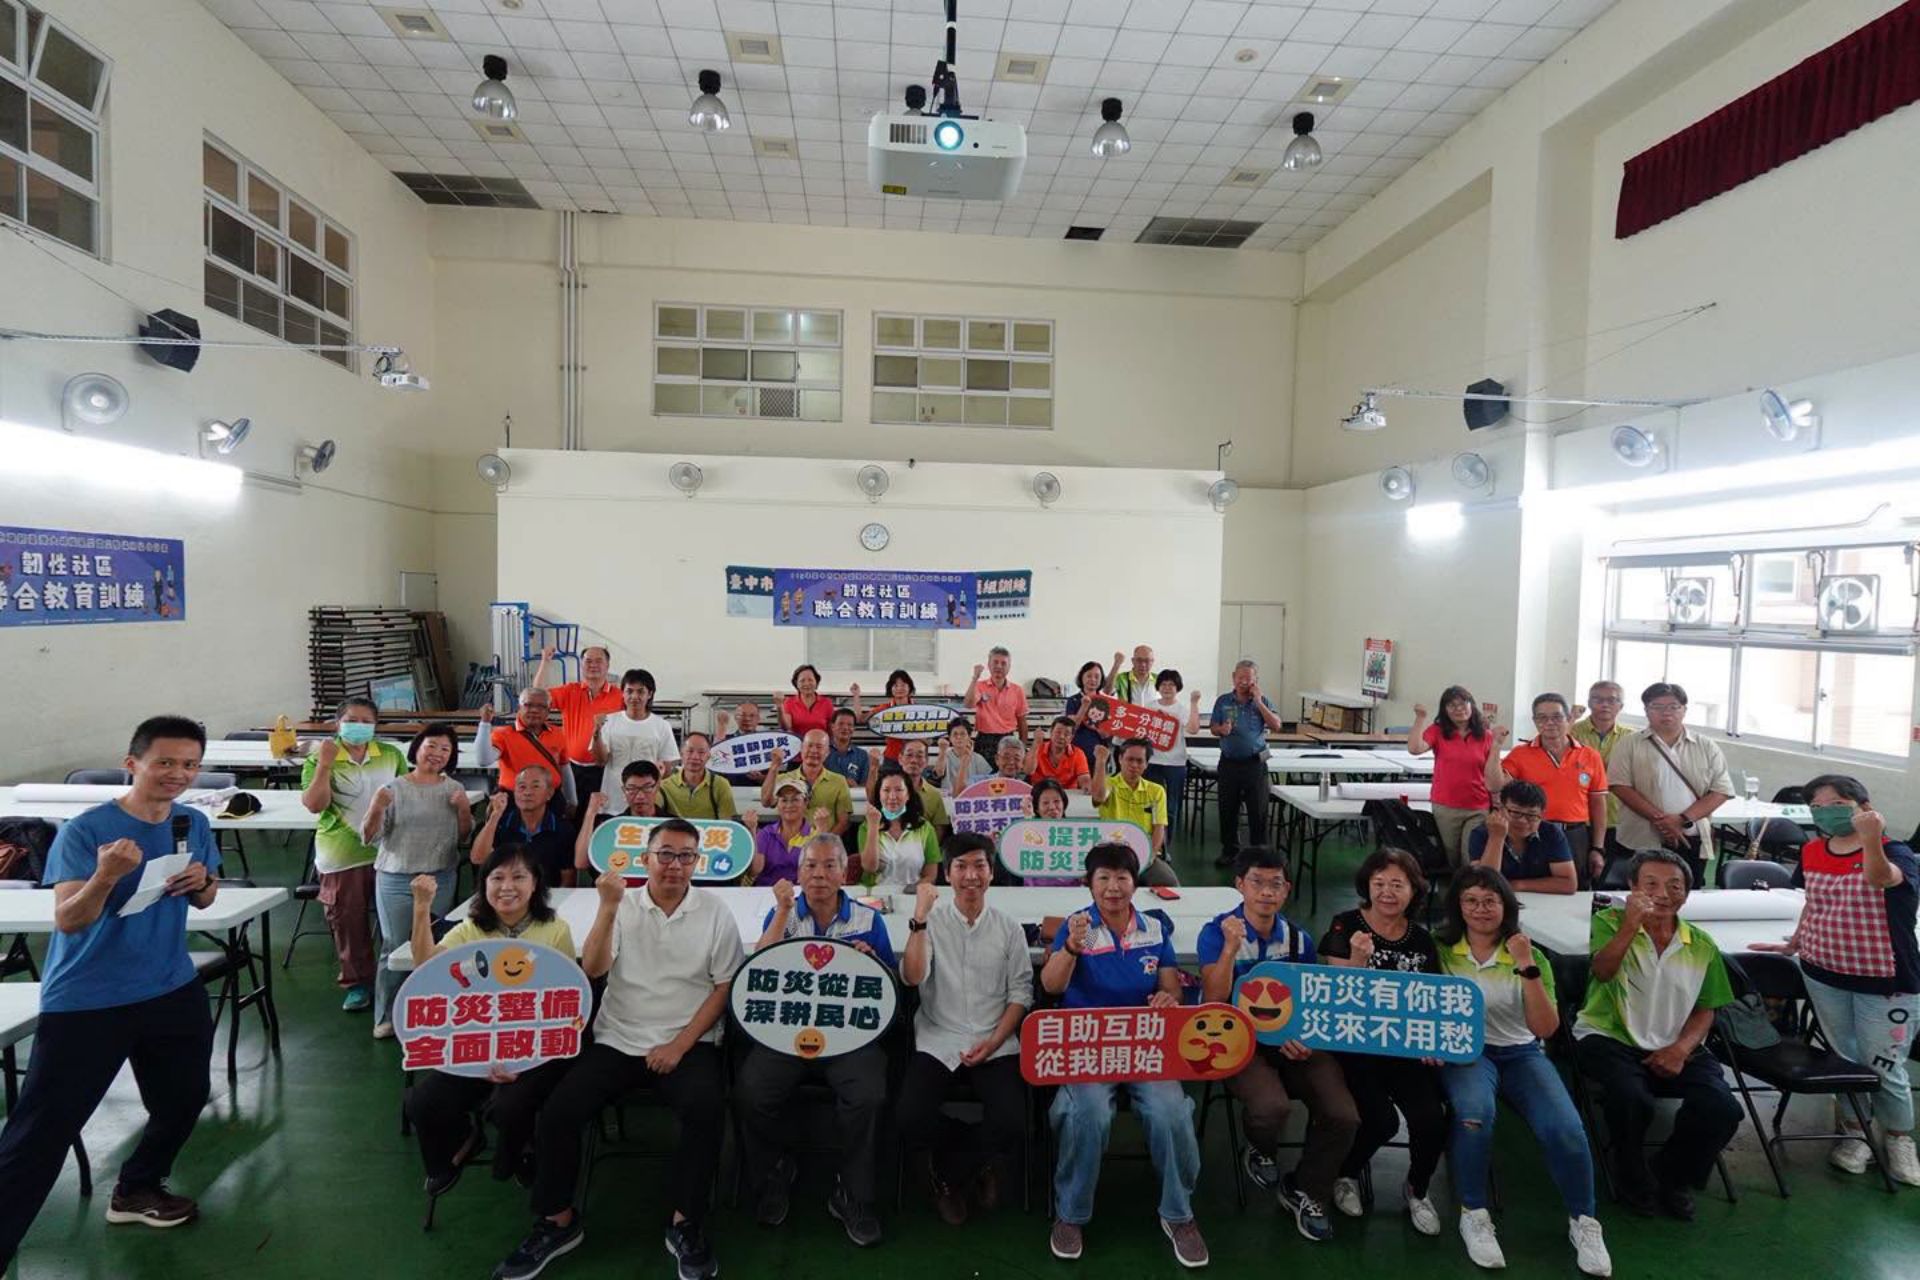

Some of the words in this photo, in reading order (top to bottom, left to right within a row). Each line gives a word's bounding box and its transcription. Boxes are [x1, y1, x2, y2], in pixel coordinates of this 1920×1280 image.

[22, 551, 112, 577] 韌性社區
[843, 583, 911, 598] 韌性社區
[814, 600, 938, 620] 聯合教育訓練
[1111, 720, 1171, 748] 少一分災害
[1115, 706, 1176, 733] 多一分準備
[1048, 826, 1102, 847] 提升
[747, 968, 883, 1000] 防災從民
[1301, 972, 1474, 1017] 防災有你我
[406, 989, 580, 1029] 防災整備
[743, 998, 881, 1030] 深耕民心
[1037, 1011, 1166, 1046] 自助互助
[1300, 1008, 1474, 1056] 災來不用愁
[404, 1027, 579, 1069] 全面啟動
[1035, 1046, 1165, 1078] 從我開始
